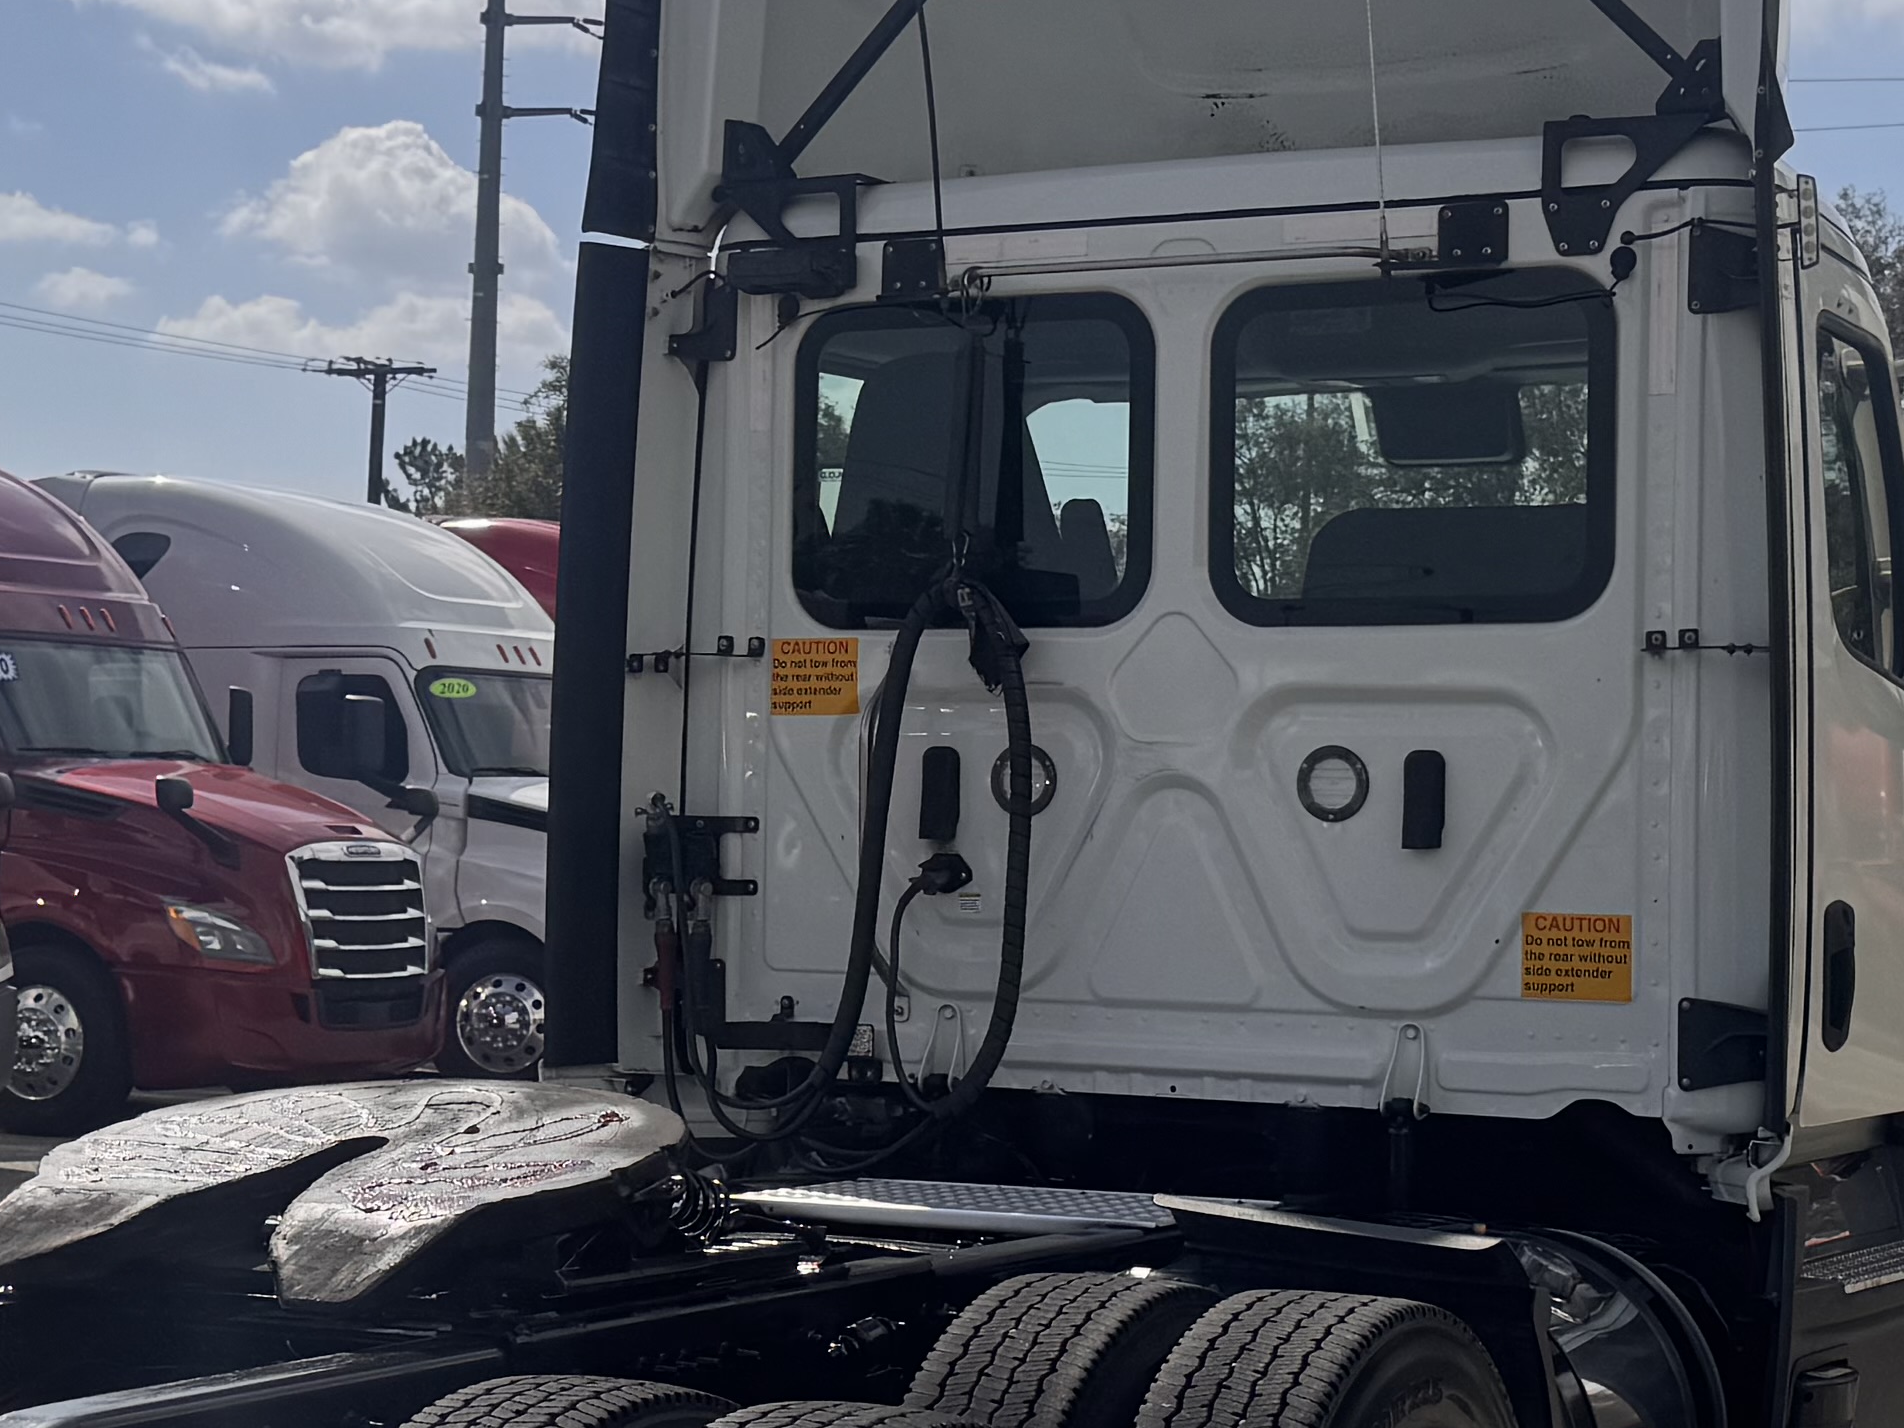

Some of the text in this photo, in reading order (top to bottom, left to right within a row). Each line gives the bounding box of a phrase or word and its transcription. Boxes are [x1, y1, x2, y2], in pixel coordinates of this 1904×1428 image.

[780, 640, 849, 654] CAUTION
[773, 658, 857, 668] Do not tow from
[772, 673, 788, 682] the
[815, 673, 854, 682] without
[439, 682, 469, 694] 2020
[771, 700, 812, 712] support
[1535, 915, 1621, 933] CAUTION
[1525, 934, 1630, 949] Do not tow from
[1525, 950, 1628, 964] the rear without
[1524, 965, 1613, 979] side extender
[1524, 982, 1575, 995] support
